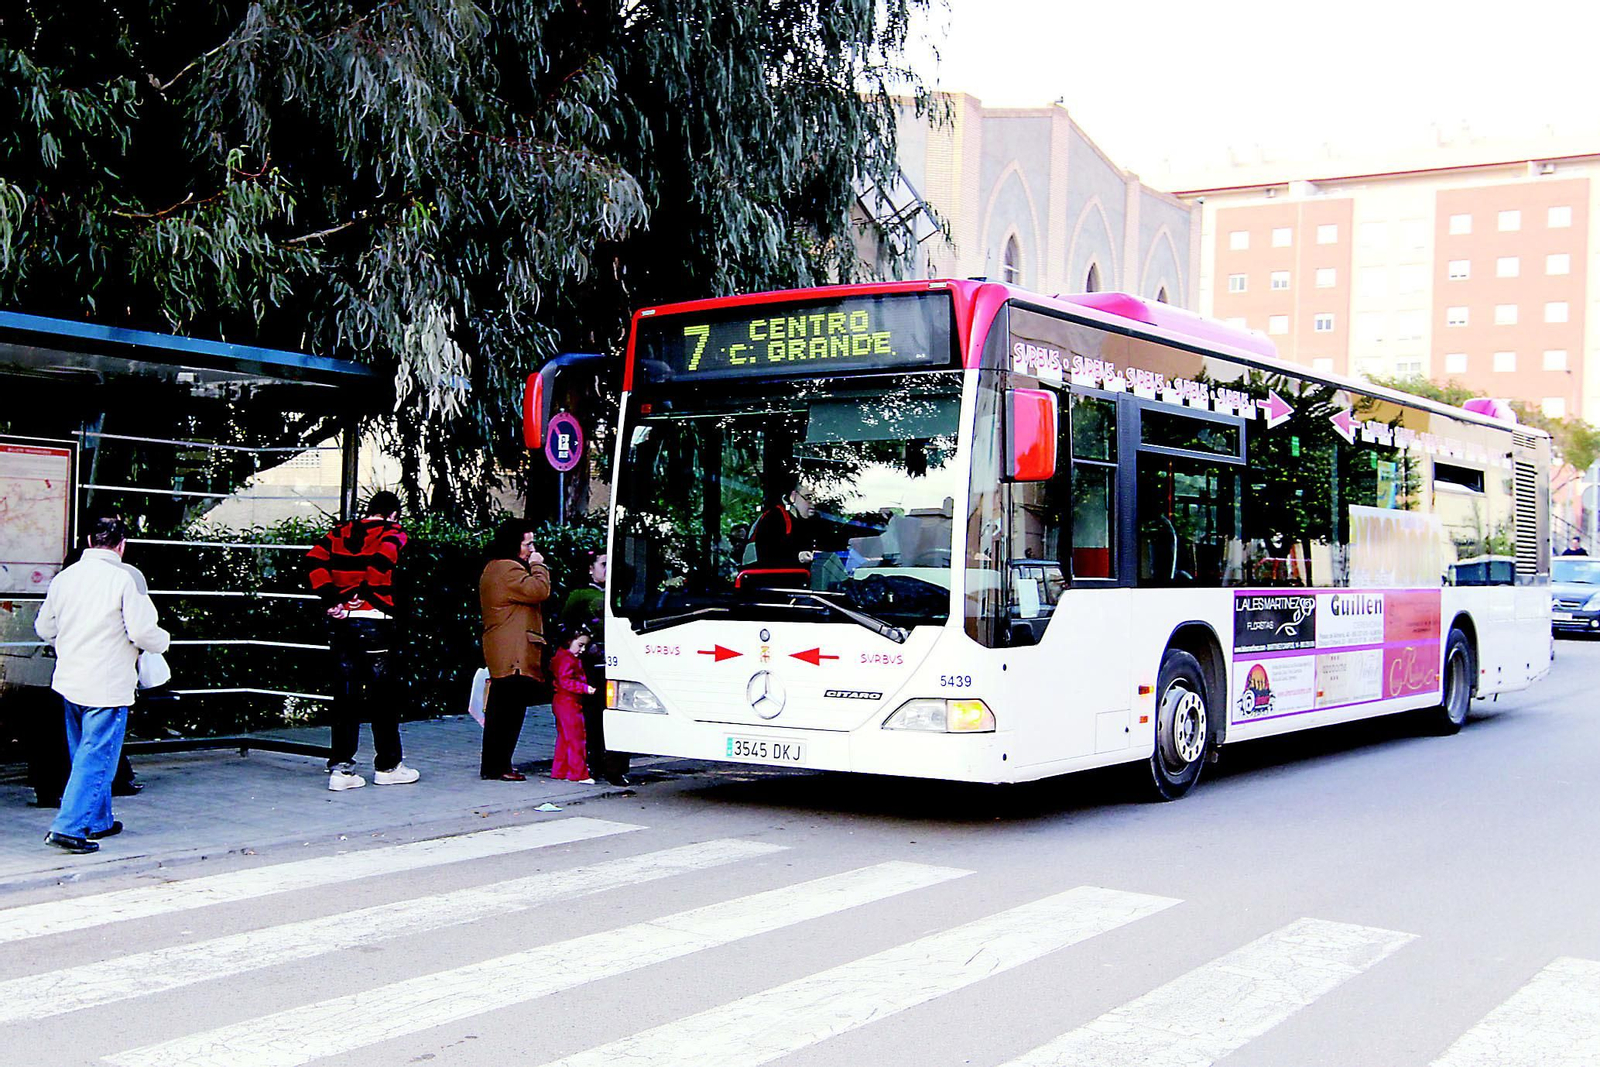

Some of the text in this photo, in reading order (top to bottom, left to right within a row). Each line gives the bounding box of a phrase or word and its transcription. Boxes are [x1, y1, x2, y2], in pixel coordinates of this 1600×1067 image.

[749, 310, 869, 341] CENTRO
[684, 325, 709, 370] 7
[1331, 594, 1382, 616] Guillen
[940, 675, 972, 688] 5439
[825, 690, 881, 700] CITARO
[734, 740, 768, 758] 3545
[773, 743, 801, 761] DKJ
